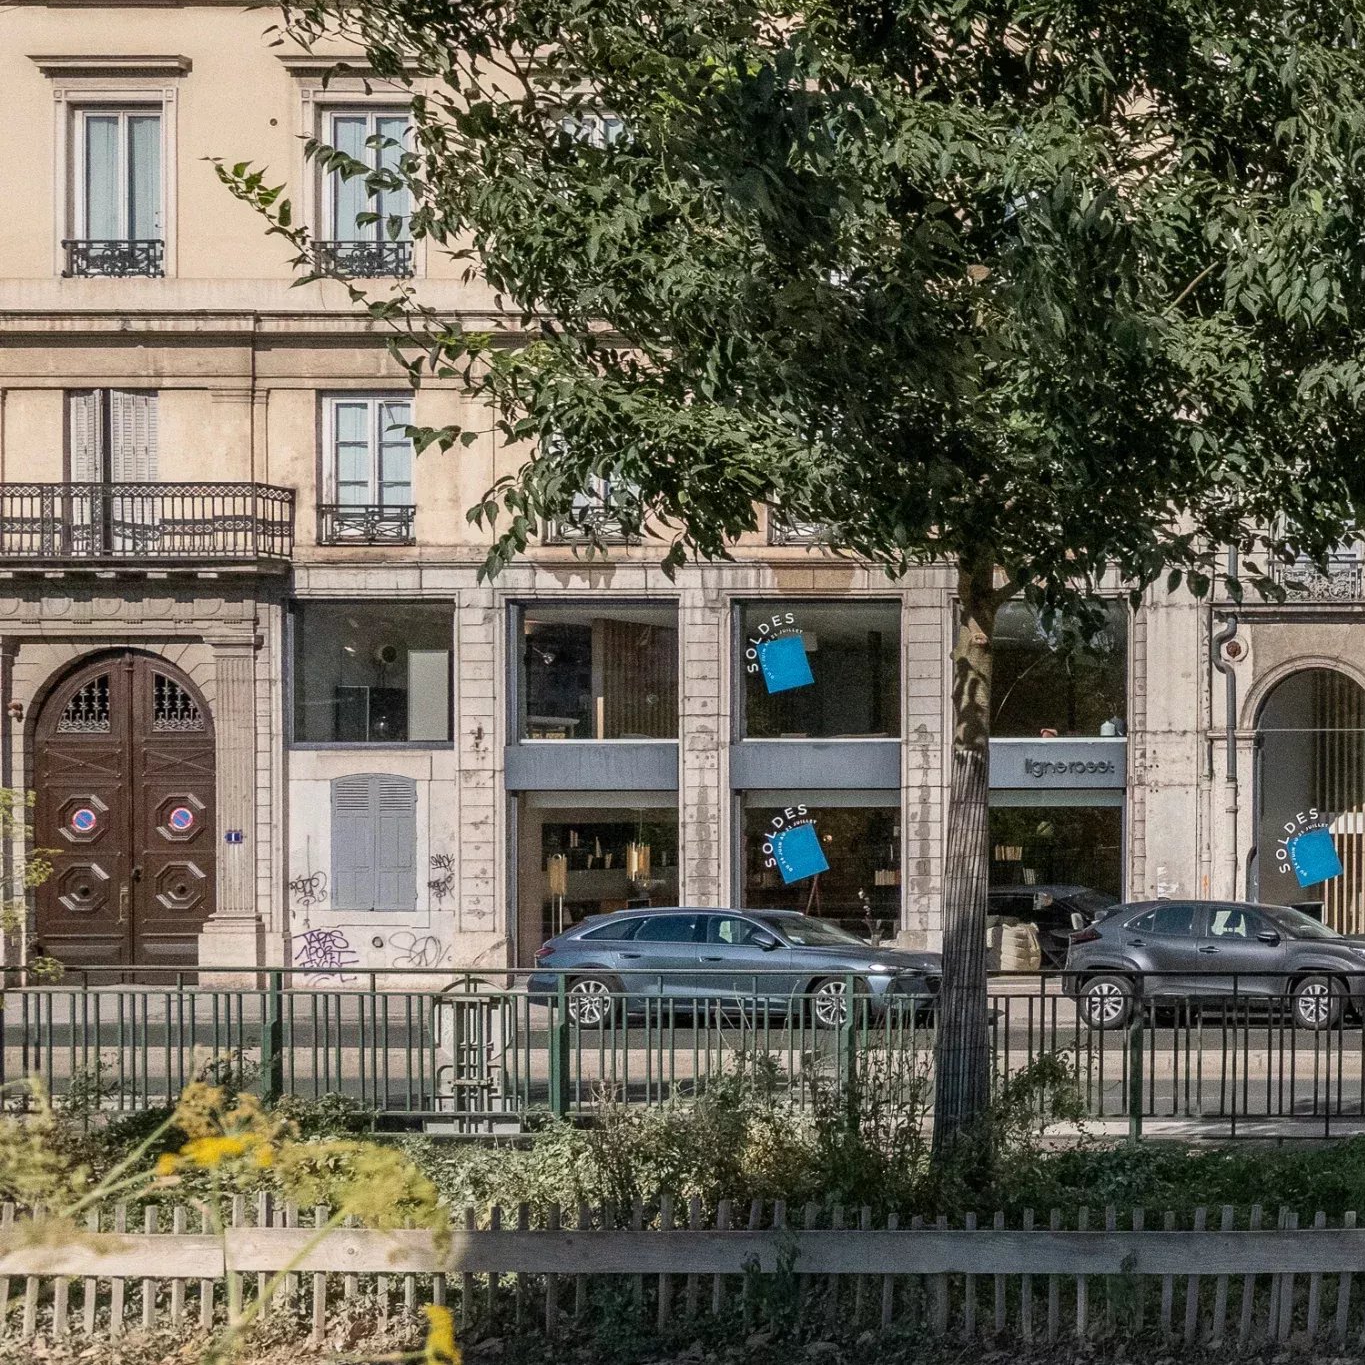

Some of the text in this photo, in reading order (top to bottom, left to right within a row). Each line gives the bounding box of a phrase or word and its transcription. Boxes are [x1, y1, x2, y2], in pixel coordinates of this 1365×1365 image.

[746, 612, 794, 673] SOLDES
[762, 804, 807, 868] SOLDES
[1276, 808, 1319, 873] SOLDES
